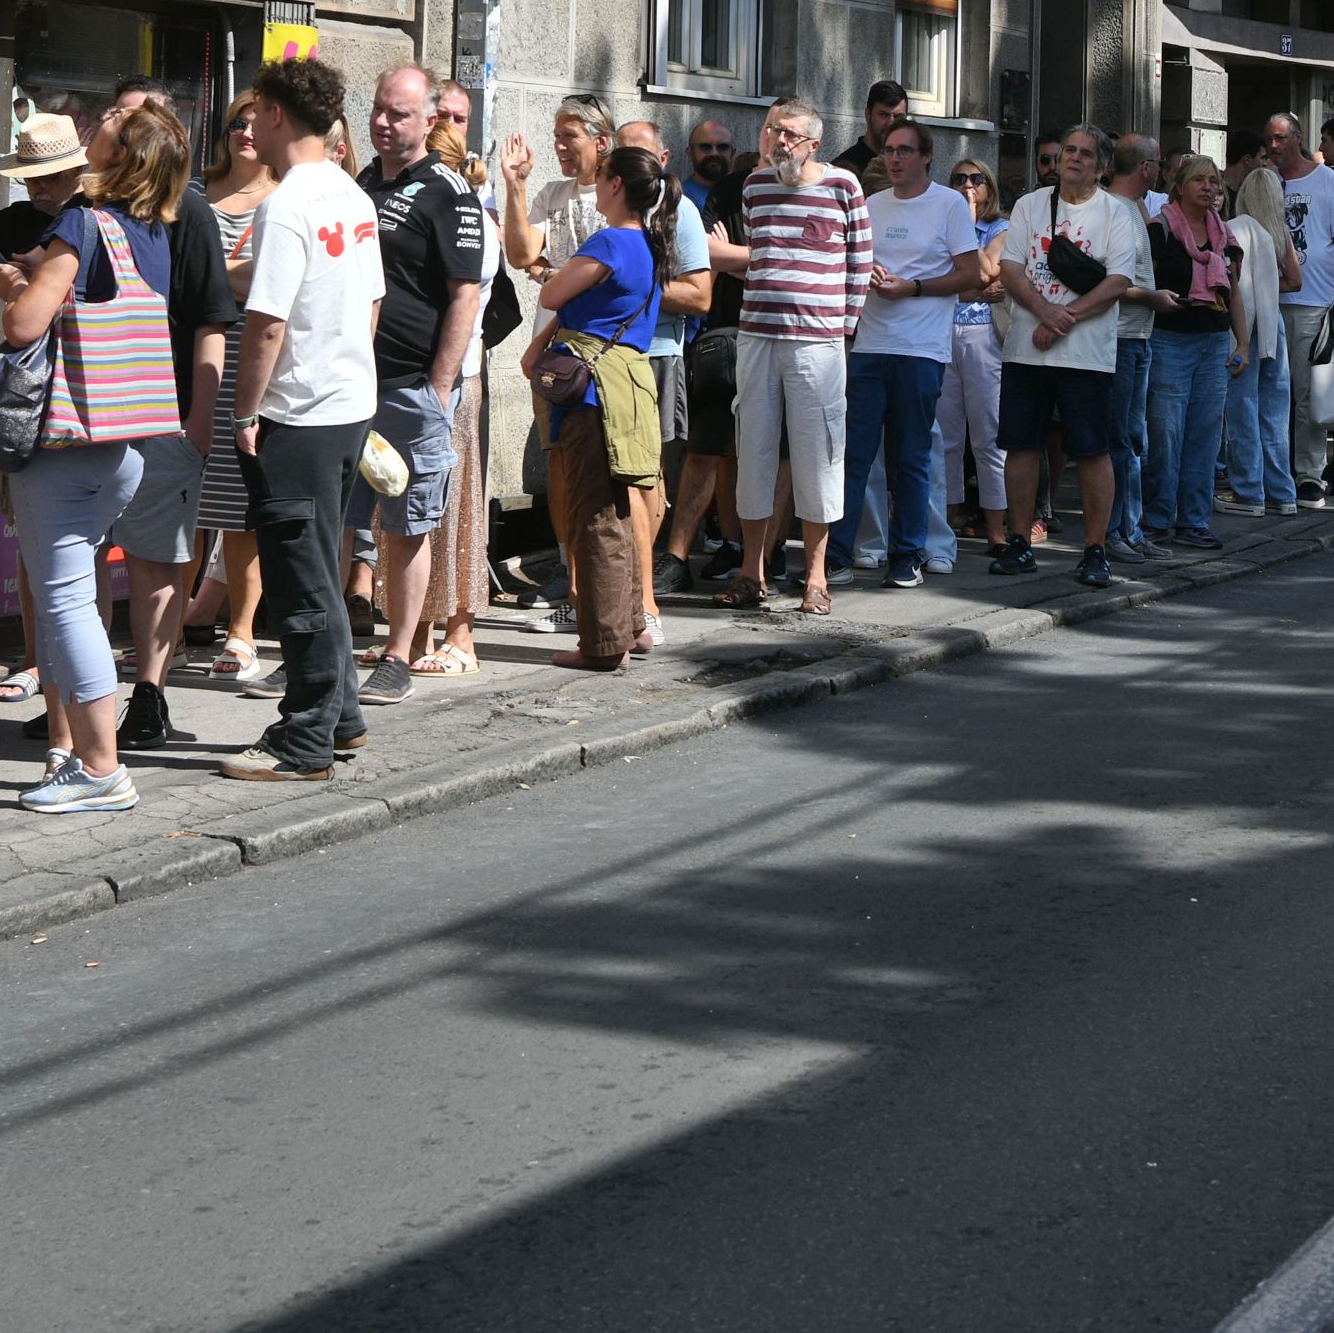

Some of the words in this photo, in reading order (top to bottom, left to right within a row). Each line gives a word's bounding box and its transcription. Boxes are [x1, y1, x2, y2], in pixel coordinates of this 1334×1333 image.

[1282, 37, 1291, 53] 37
[384, 198, 411, 213] INEOS
[461, 215, 478, 225] IWC
